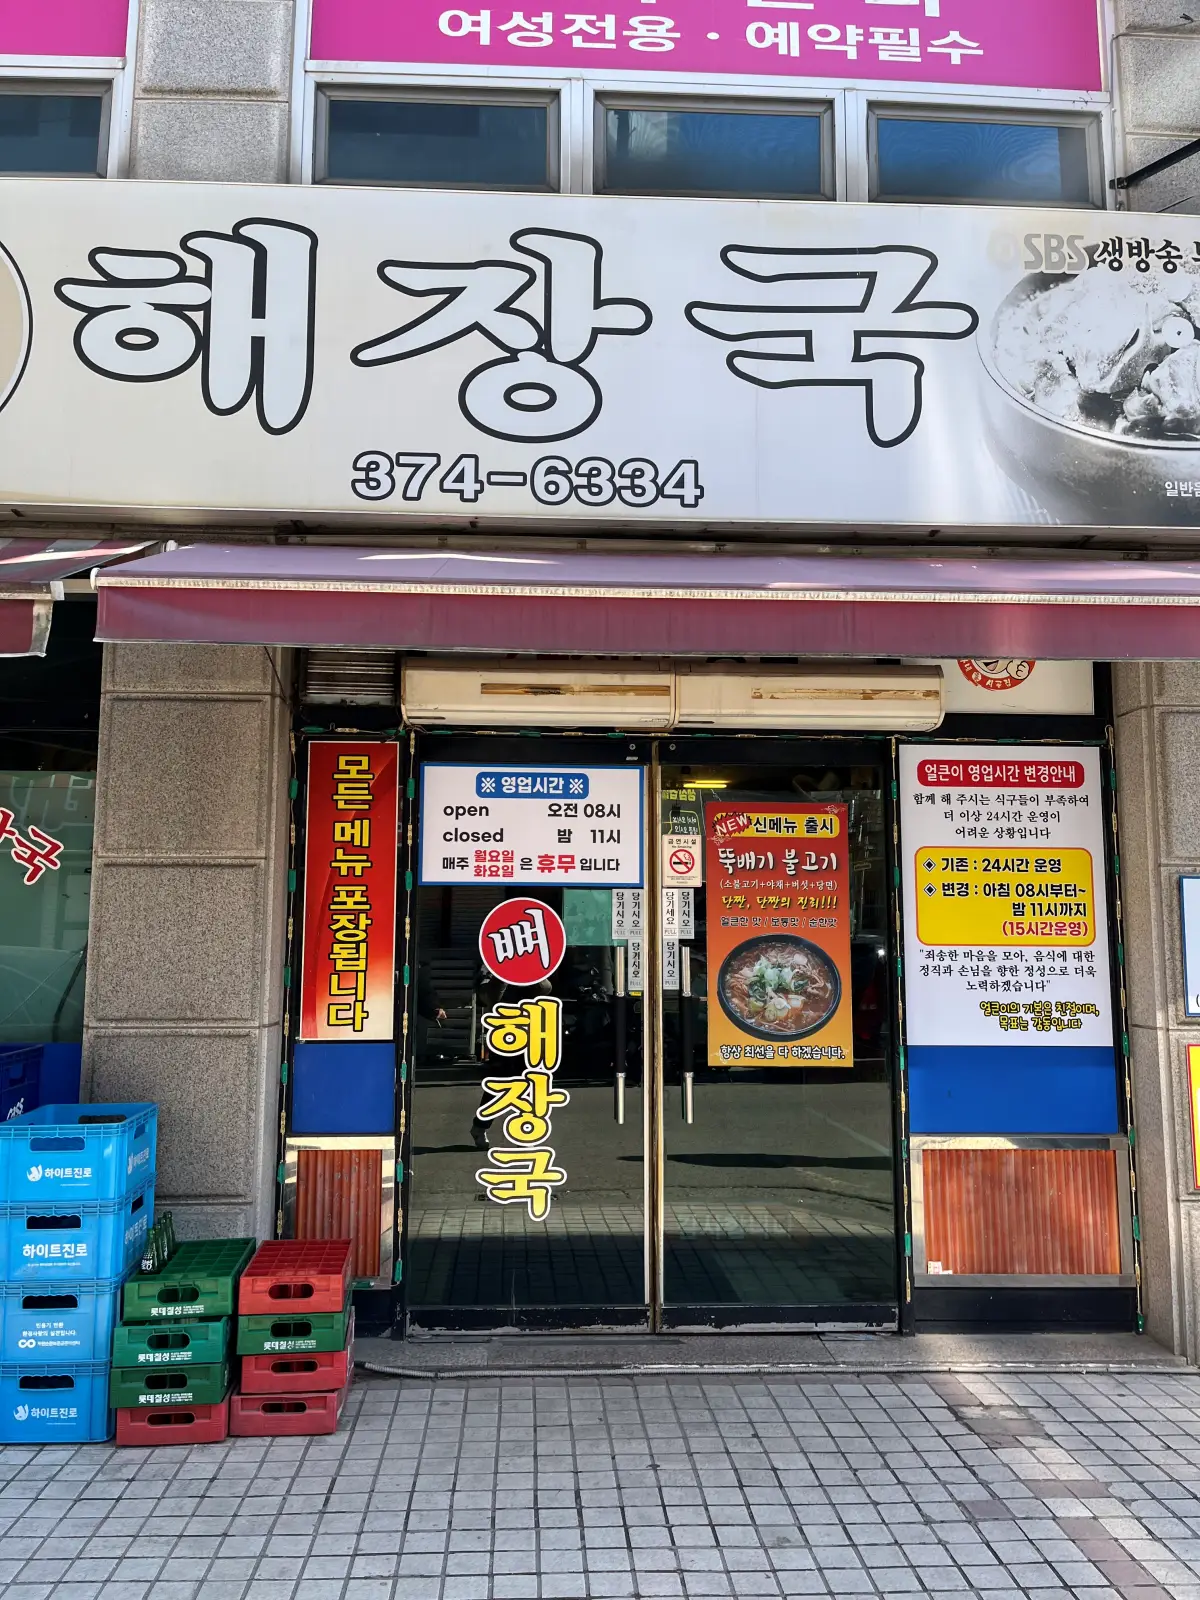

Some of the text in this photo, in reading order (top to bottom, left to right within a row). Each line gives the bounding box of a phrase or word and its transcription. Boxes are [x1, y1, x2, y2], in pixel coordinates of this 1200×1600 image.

[437, 8, 682, 53] 여성전용
[745, 21, 984, 65] 예약필수
[1023, 233, 1088, 272] SBS
[1097, 236, 1183, 274] 생방송
[54, 217, 980, 449] 해장국
[351, 450, 705, 508] 374-6334
[924, 763, 1076, 783] 얼큰이 영업시간 변경안내
[501, 776, 565, 794] 영업시간
[913, 793, 1089, 807] 함께 해 주시는 식구들이 부족하여
[443, 803, 621, 820] open 오전 08시
[944, 810, 1061, 823] 더 이상 24시간 운영이
[716, 813, 749, 836] NEW
[753, 816, 834, 835] 신메뉴 출시
[955, 827, 1051, 839] 어려운 상황입니다
[442, 827, 621, 844] closed 밤 11시
[442, 849, 620, 873] 매주 월요일 은 휴무 입니다
[717, 848, 838, 875] 뚝배기 불고기
[941, 857, 969, 872] 기존
[982, 858, 1030, 873] 24시간
[1034, 858, 1062, 873] 운영
[473, 864, 514, 878] 화요일
[326, 754, 375, 1032] 모든 메뉴 포장됩니다
[941, 882, 970, 897] 변경
[983, 882, 1010, 898] 아침
[1015, 882, 1086, 898] 08시부터~
[616, 891, 625, 928] 당기시오
[632, 892, 641, 928] 당기시오
[665, 891, 675, 925] 당기세요
[681, 891, 691, 927] 당기시오
[756, 895, 791, 909] 단짠의
[1012, 902, 1087, 917] 밤 11시까지
[720, 916, 749, 927] 얼큰한
[752, 916, 762, 927] 맛
[771, 916, 800, 928] 보통맛
[808, 917, 838, 928] 순한맛
[1002, 920, 1088, 937] (15시간운영)
[487, 907, 551, 970] 뼈
[632, 942, 640, 978] 당기시오
[666, 941, 675, 978] 당기시오
[963, 949, 997, 963] 마음을
[1002, 950, 1028, 963] 모아,
[1033, 950, 1067, 963] 음식에
[1072, 951, 1096, 963] 대한
[919, 964, 1097, 978] 정직과 손님을 향한 정성으로 더욱
[979, 1001, 1021, 1017] 얼큰이의
[1022, 1001, 1053, 1016] 기본은
[999, 1016, 1083, 1032] 목표는 감동입니다
[720, 1045, 742, 1059] 항상
[744, 1045, 775, 1059] 최선을
[777, 1045, 789, 1059] 다
[476, 996, 569, 1221] 해장국
[44, 1167, 92, 1179] 하이트진로
[22, 1243, 88, 1259] 하이트진로
[31, 1407, 78, 1419] 하이트진로
